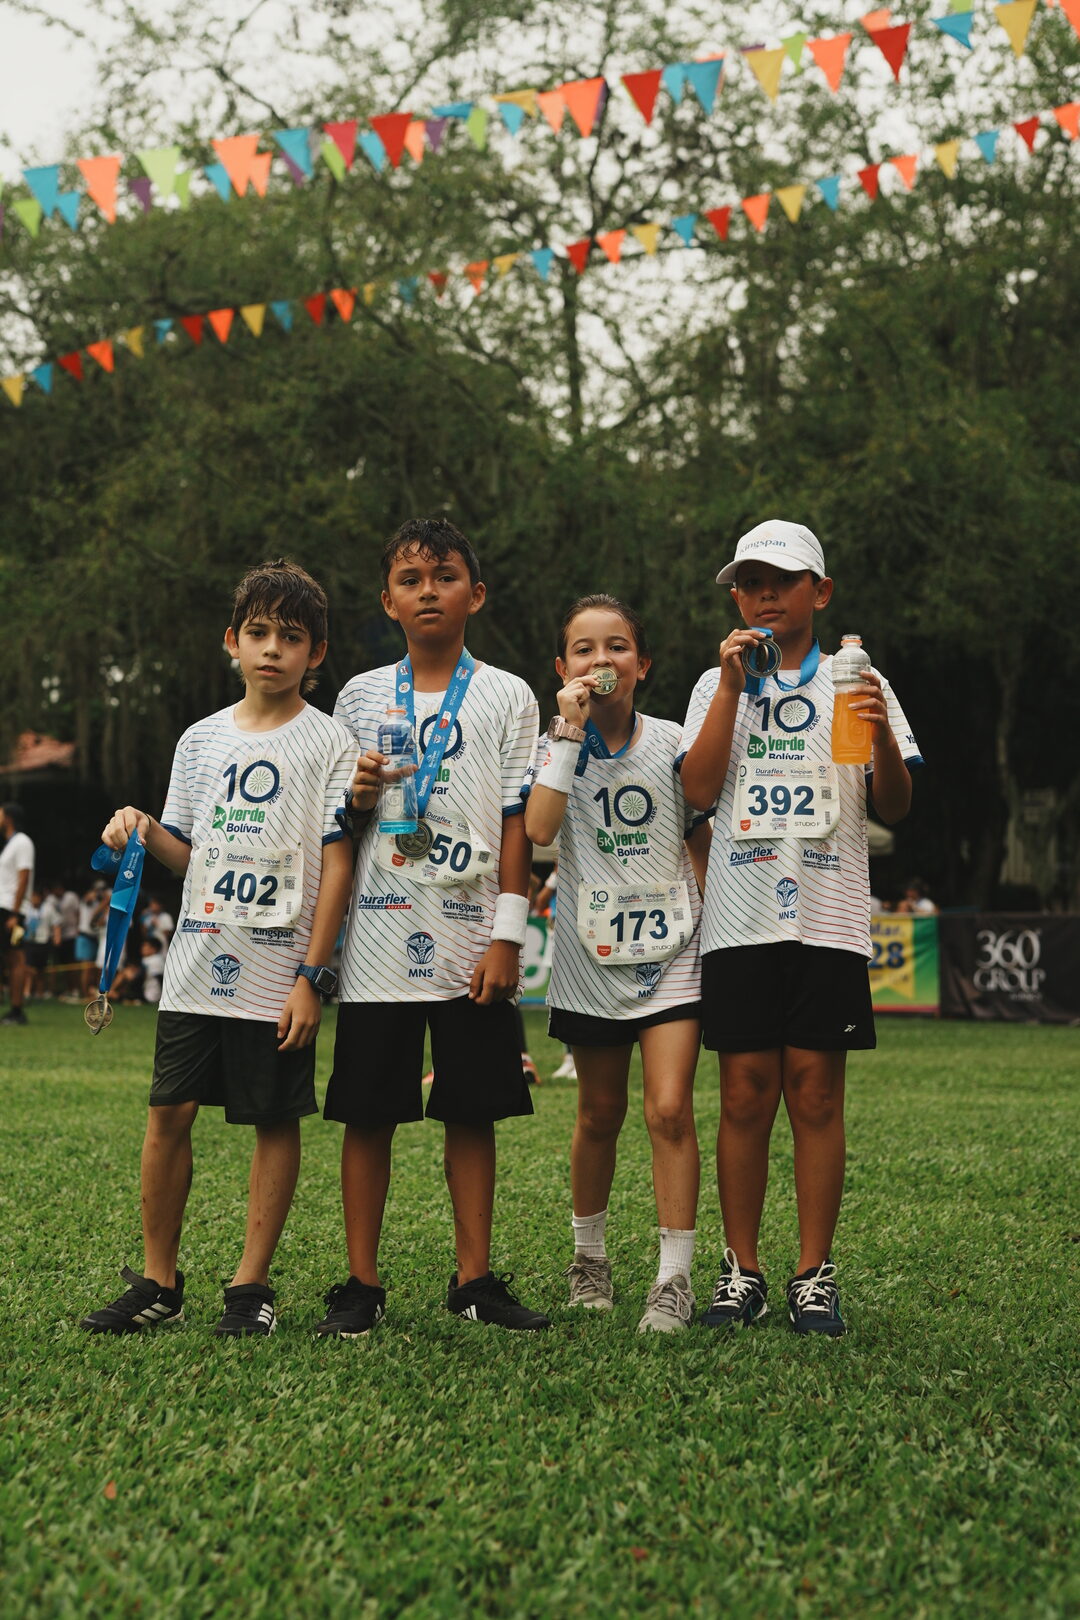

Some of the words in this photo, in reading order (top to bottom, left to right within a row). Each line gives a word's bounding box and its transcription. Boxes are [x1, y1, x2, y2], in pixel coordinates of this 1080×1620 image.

[755, 695, 816, 733] 10
[805, 714, 821, 733] YEARS
[451, 741, 467, 762] YEARS
[748, 743, 764, 754] 5K
[223, 760, 280, 803] 10
[267, 786, 284, 805] YEARS
[748, 785, 814, 816] 392
[593, 785, 653, 827] 10
[426, 811, 452, 825] Duraflex
[645, 806, 658, 826] YEARS
[227, 823, 263, 834] Bolívar
[598, 837, 612, 847] 5K
[208, 848, 220, 860] 10
[227, 853, 254, 861] Duraflex
[428, 833, 472, 872] 50
[617, 847, 650, 857] Bolívar
[730, 847, 773, 861] Duraflex
[213, 870, 278, 906] 402
[358, 893, 408, 904] Duraflex
[591, 890, 609, 903] 10
[779, 910, 796, 920] MNS
[610, 909, 668, 942] 173
[252, 928, 294, 940] Kingspan
[408, 968, 434, 978] MNS
[210, 987, 235, 997] MNS
